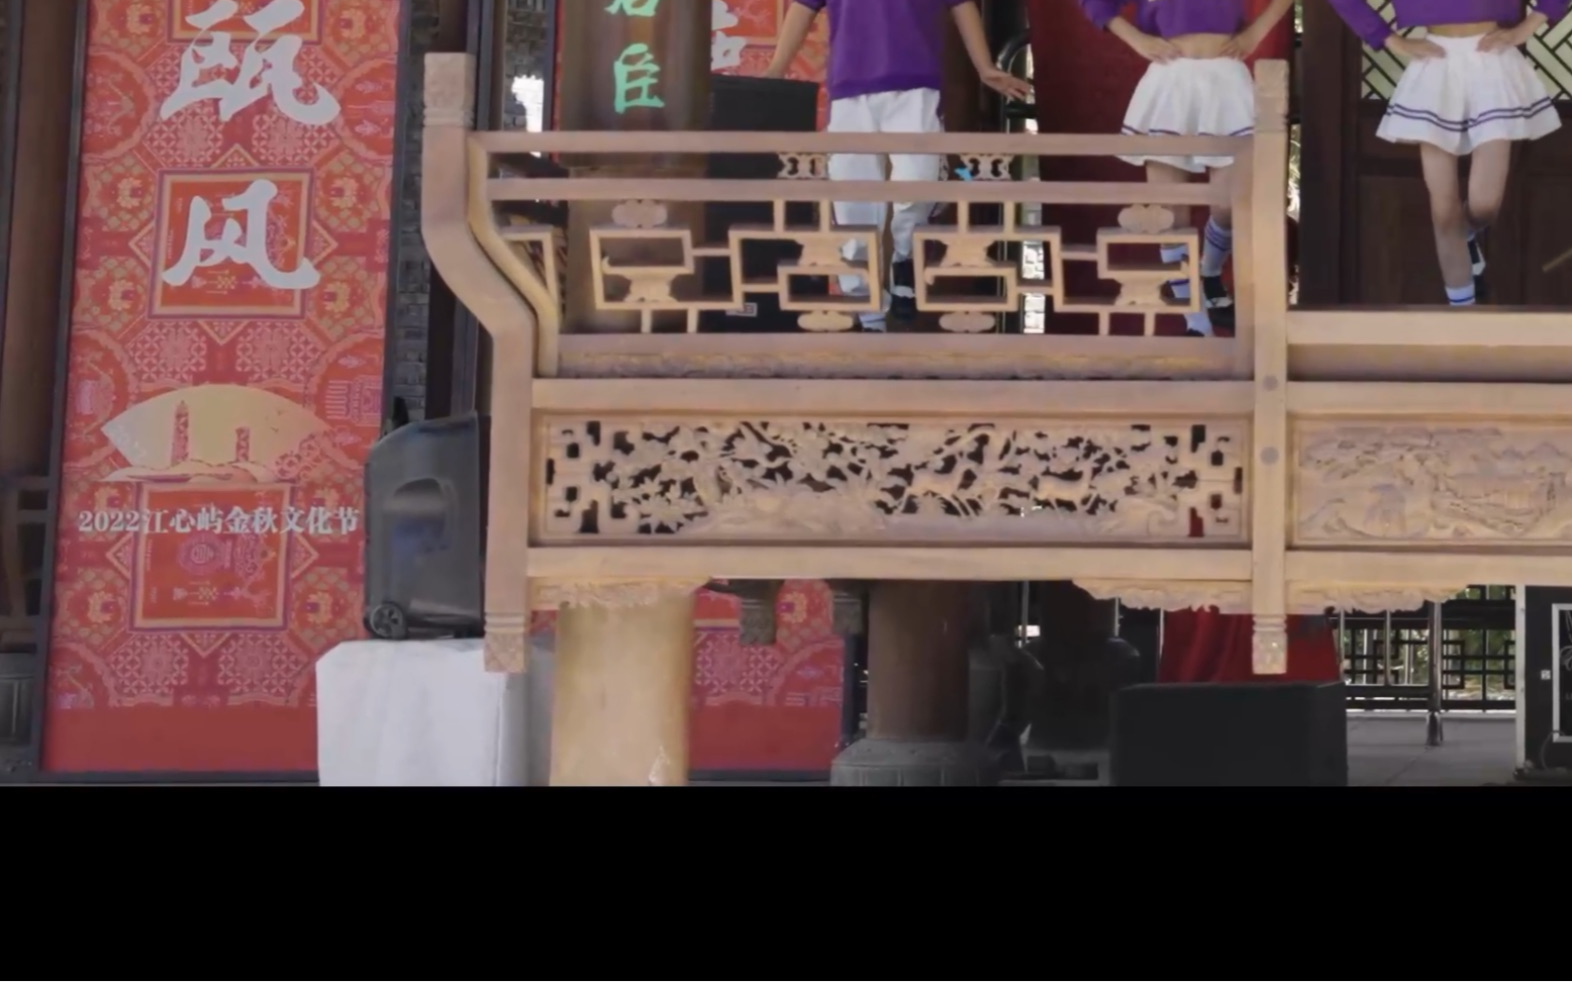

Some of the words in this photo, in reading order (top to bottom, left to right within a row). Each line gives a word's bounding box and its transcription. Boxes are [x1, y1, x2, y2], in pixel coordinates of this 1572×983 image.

[78, 505, 360, 536] 2022江心屿金秋文化节
